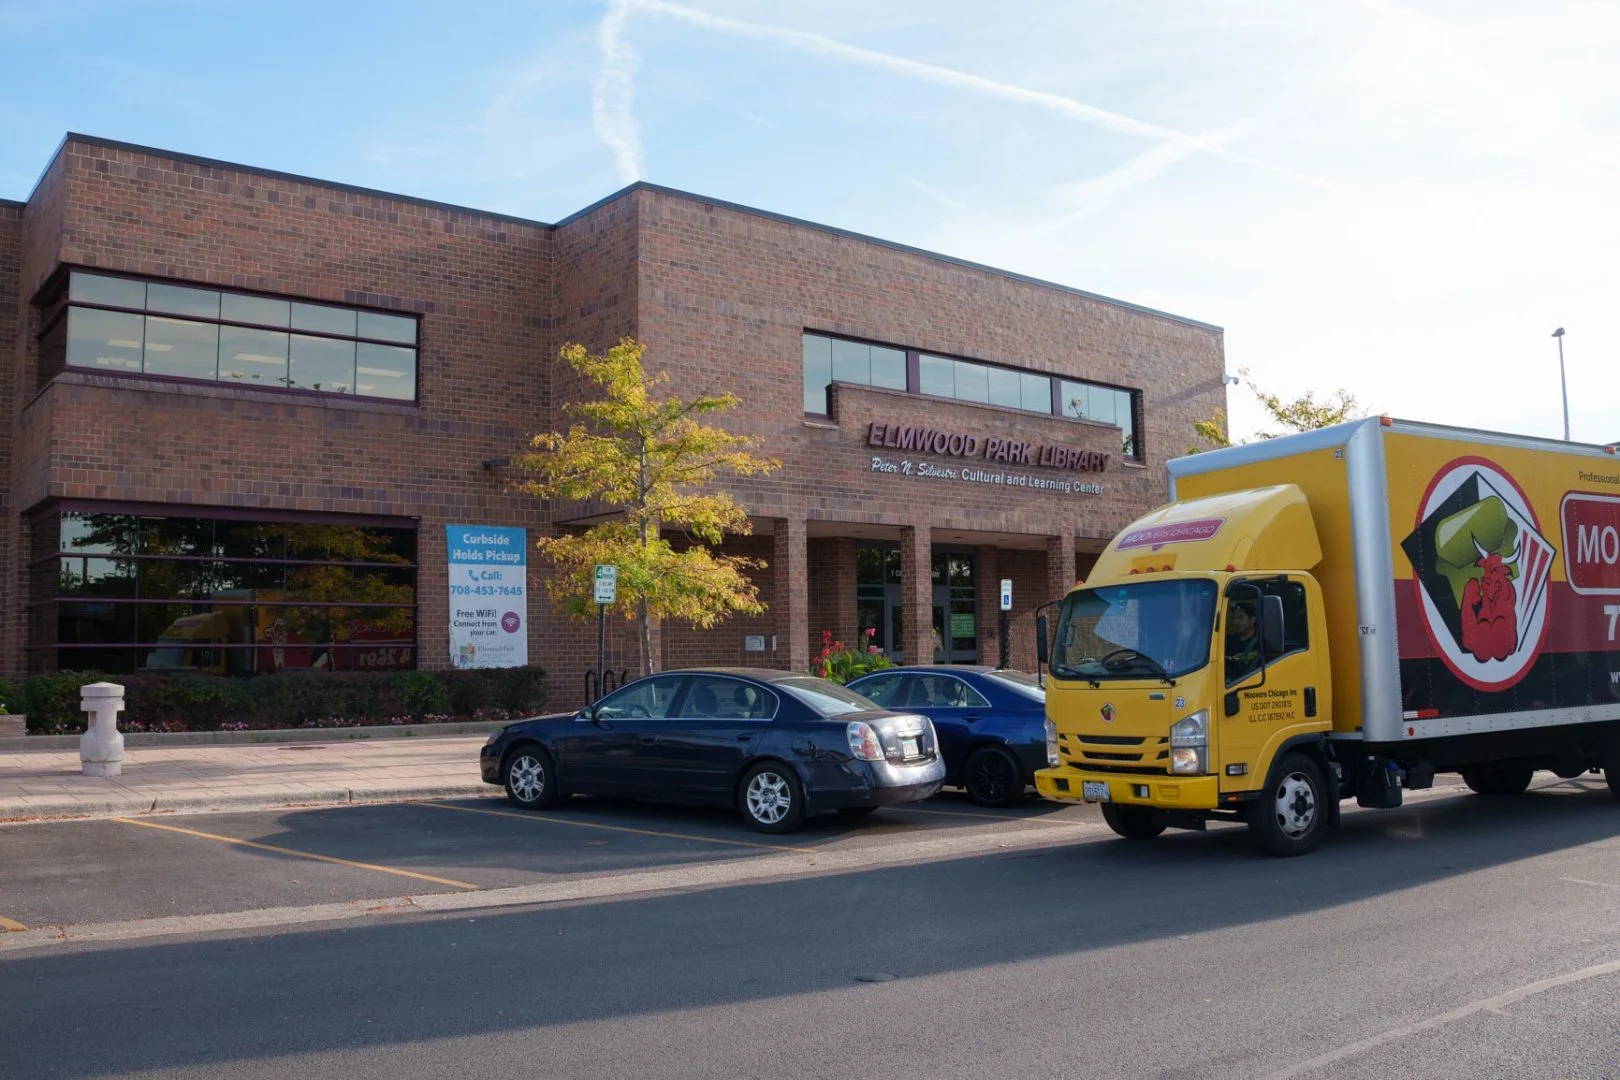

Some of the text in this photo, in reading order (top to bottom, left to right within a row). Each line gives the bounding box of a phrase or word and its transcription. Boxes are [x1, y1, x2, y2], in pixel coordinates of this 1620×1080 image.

[868, 422, 1112, 473] ELMWOOD PARK LIBRARY
[871, 457, 897, 473] Peter
[917, 463, 958, 480] Silvestri
[961, 468, 1004, 484] Cultural
[1007, 474, 1026, 487] and
[1028, 475, 1070, 494] Learning
[1073, 480, 1104, 496] Center
[1578, 471, 1620, 485] Professional
[1171, 525, 1216, 537] CHICAGO
[463, 533, 510, 545] Curbside
[453, 550, 521, 563] Holds Pickup
[481, 570, 503, 581] Call:
[451, 585, 523, 596] 708-453-7645
[456, 609, 497, 618] Free WiFi!
[453, 620, 481, 628] Connect
[1244, 688, 1297, 699] Moovers Chicago Inc
[1175, 698, 1185, 708] 23
[1251, 702, 1259, 710] US
[1260, 701, 1271, 710] DOT
